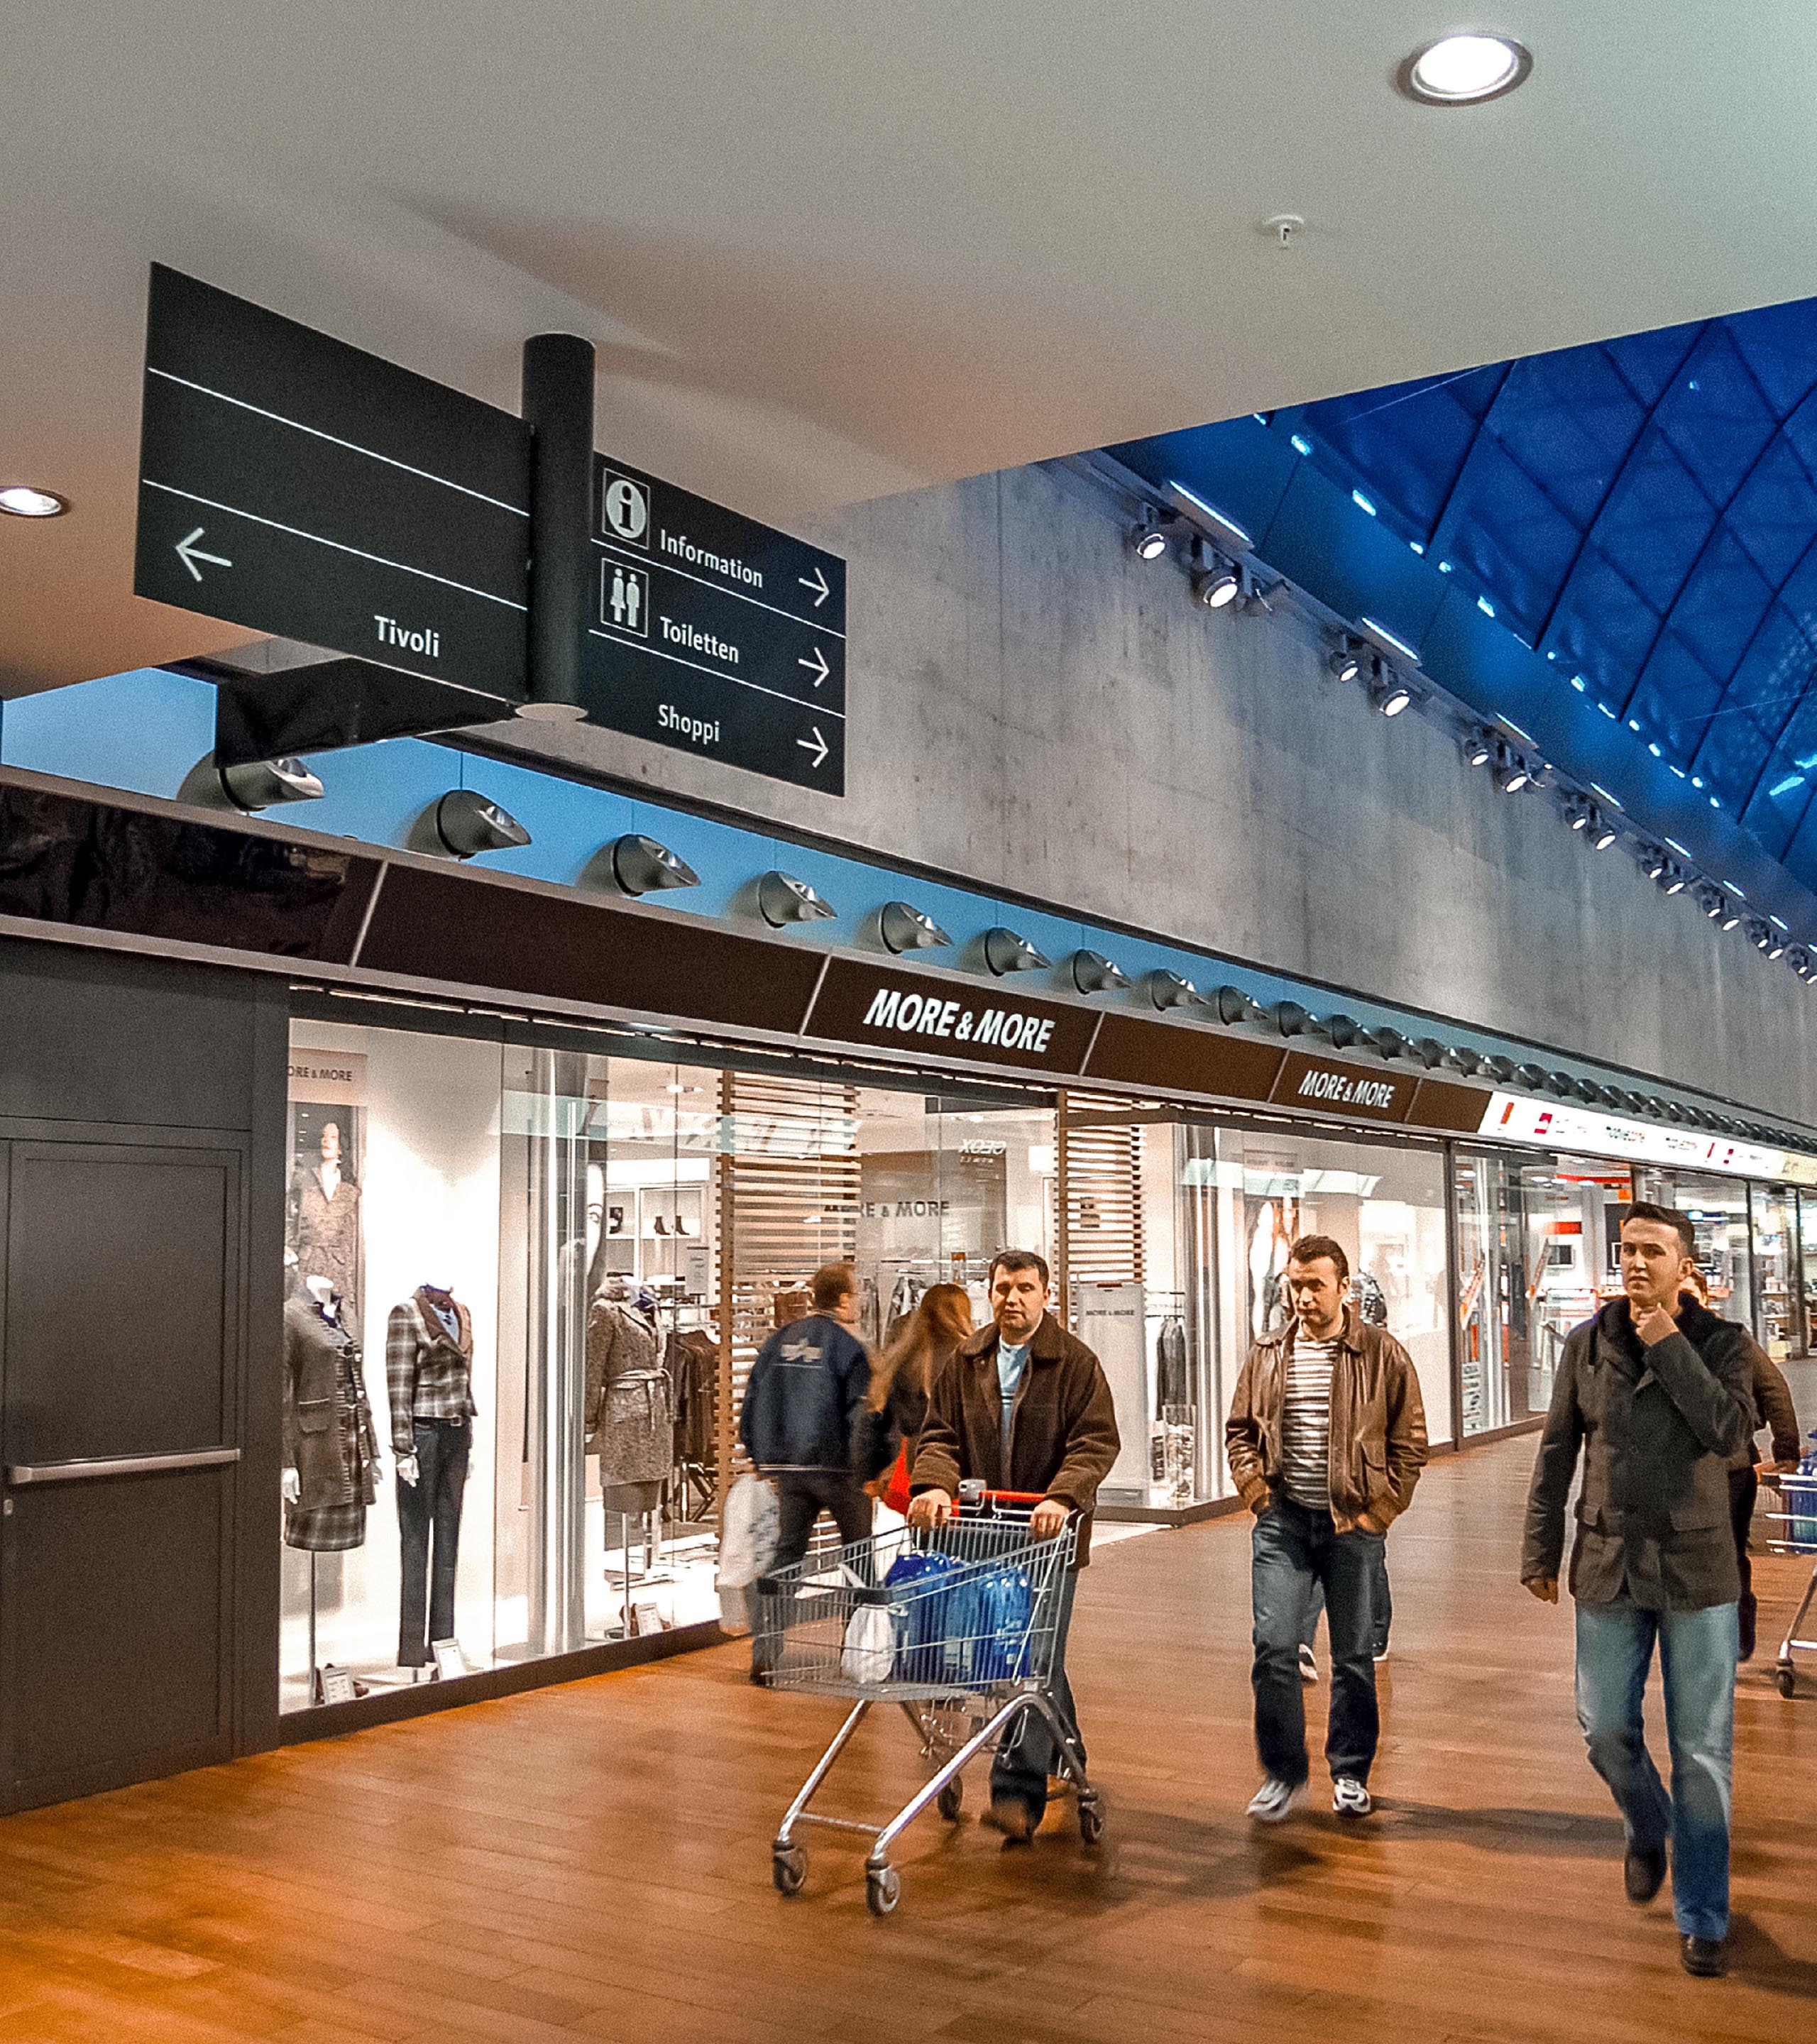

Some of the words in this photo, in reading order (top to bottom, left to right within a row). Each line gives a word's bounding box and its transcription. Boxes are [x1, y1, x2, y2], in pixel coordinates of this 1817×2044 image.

[661, 529, 763, 588] Information
[374, 615, 439, 658] Tivoli
[659, 616, 739, 664] Toiletten
[658, 703, 720, 745] Shoppi
[320, 1070, 352, 1081] MORE
[896, 1201, 950, 1217] MORE
